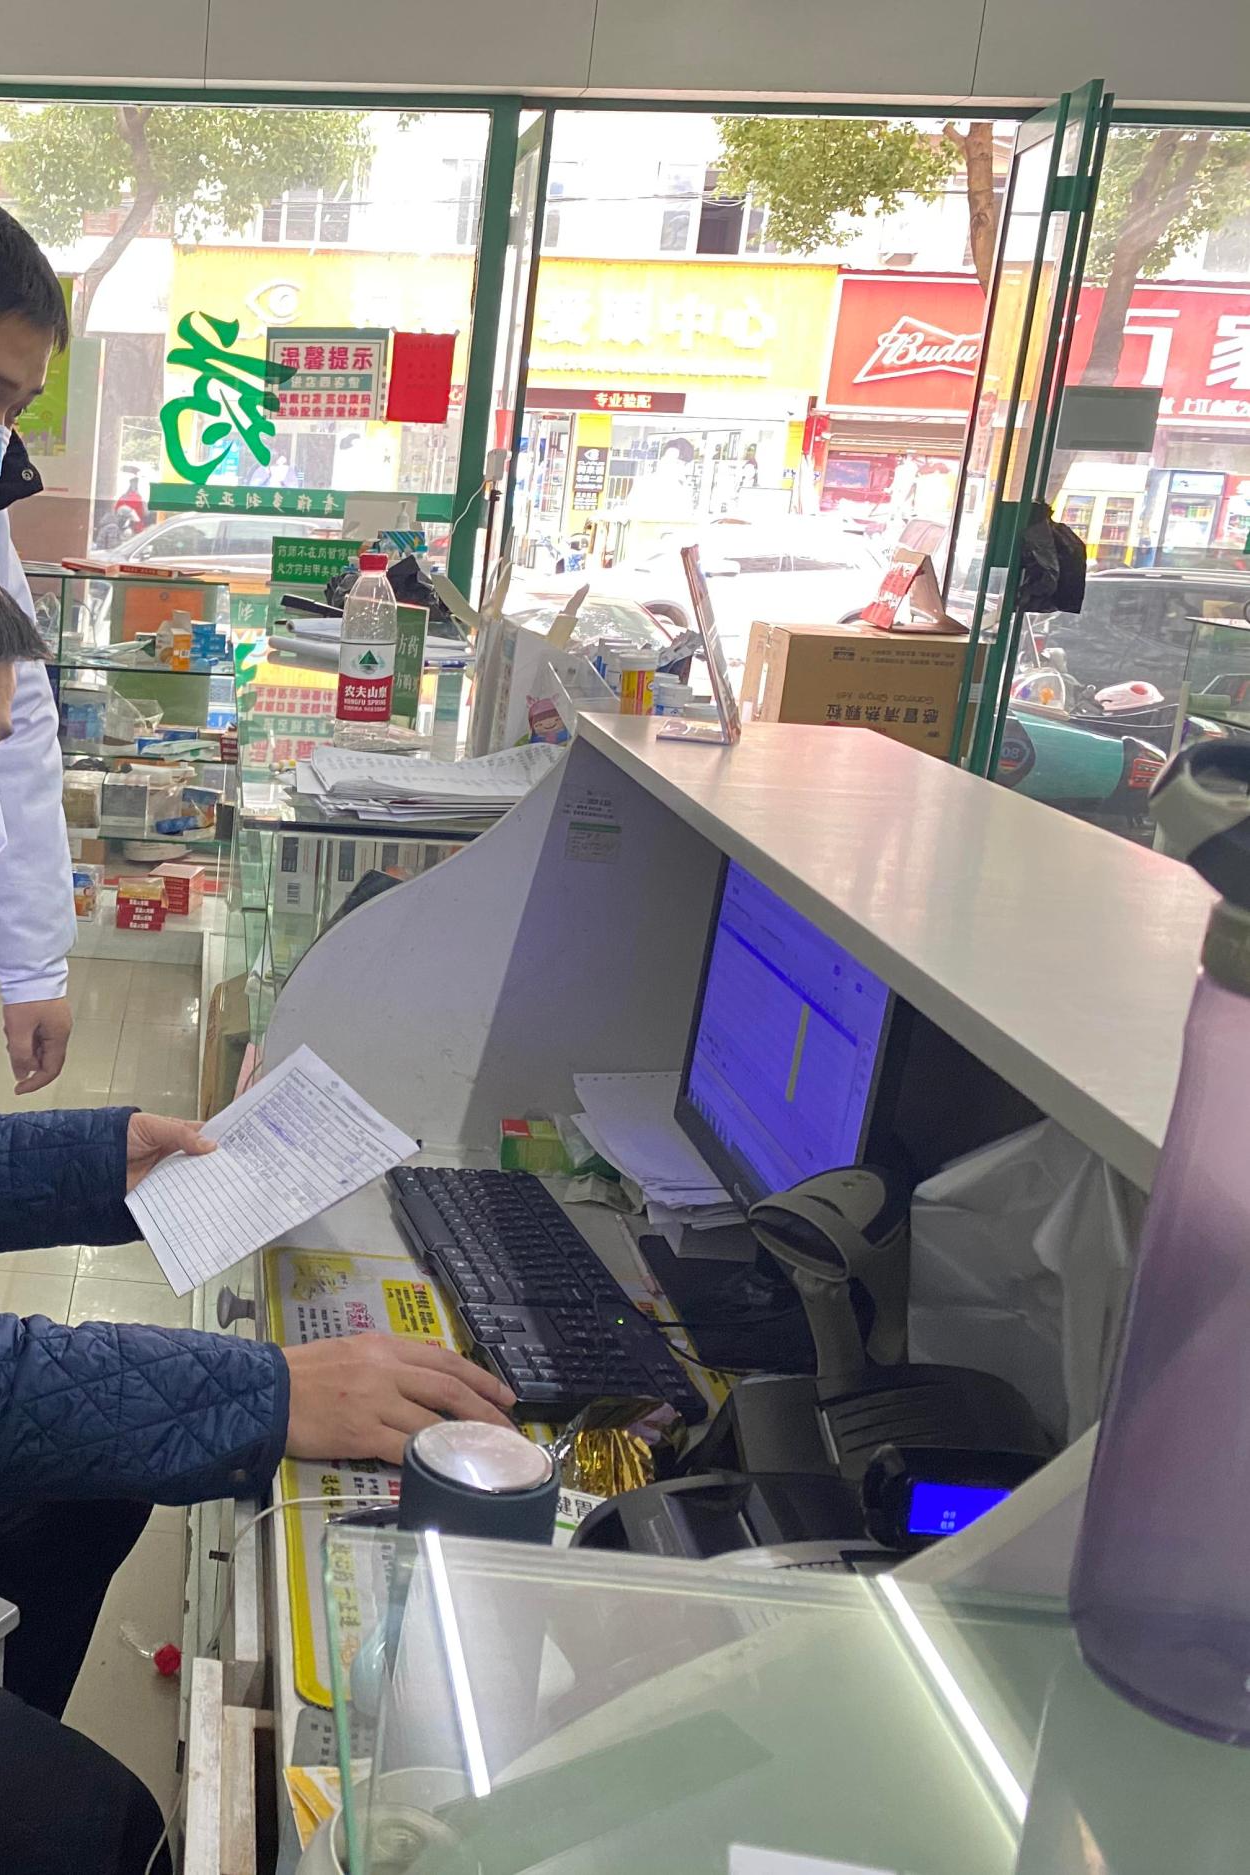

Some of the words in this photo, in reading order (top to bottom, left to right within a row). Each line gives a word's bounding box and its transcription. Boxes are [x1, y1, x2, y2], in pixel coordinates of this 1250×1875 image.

[281, 346, 373, 370] 温馨提示
[595, 393, 652, 408] 专业验配
[345, 685, 388, 698] 农夫山泉
[825, 704, 940, 724] 感冒清热颗粒
